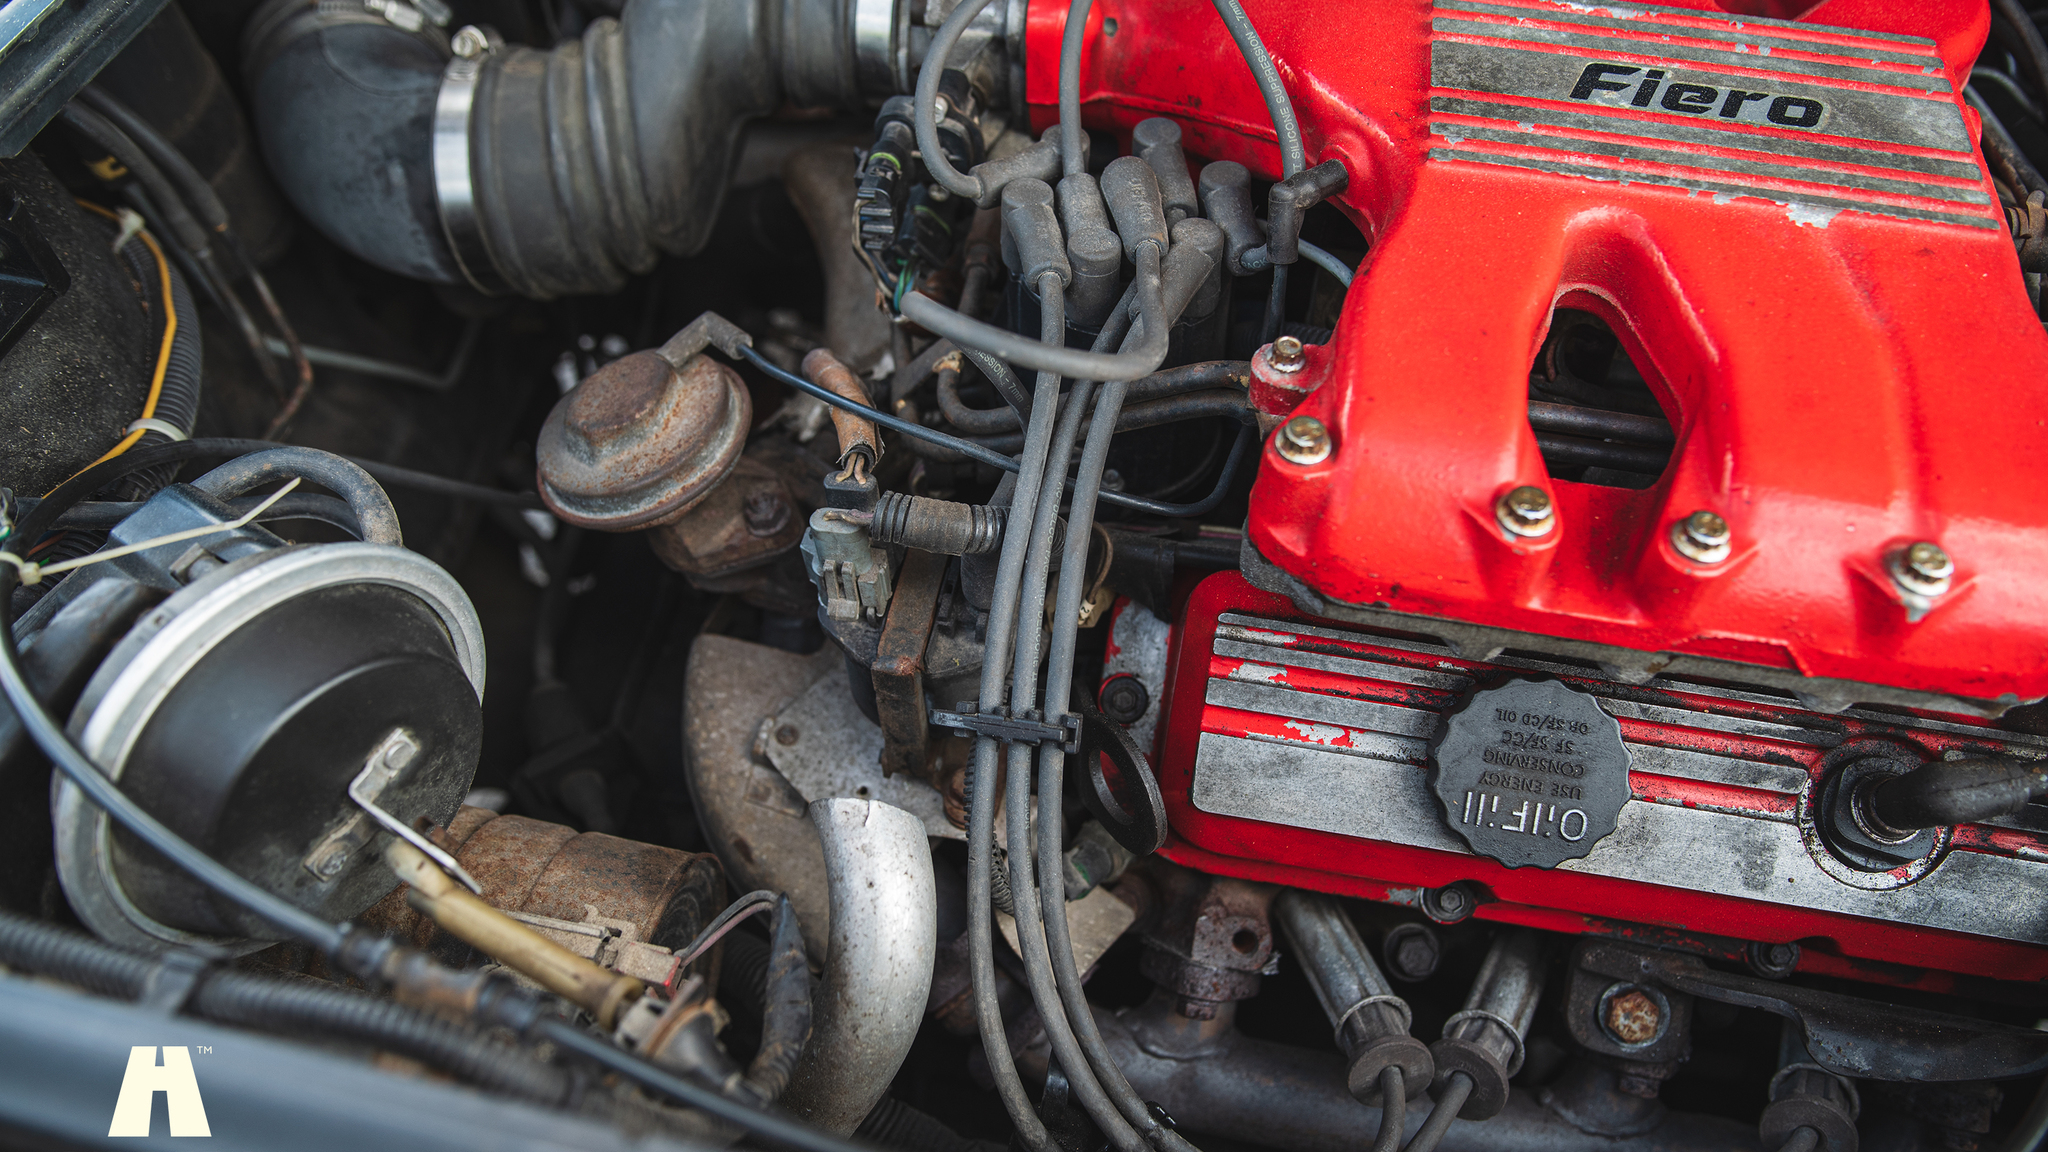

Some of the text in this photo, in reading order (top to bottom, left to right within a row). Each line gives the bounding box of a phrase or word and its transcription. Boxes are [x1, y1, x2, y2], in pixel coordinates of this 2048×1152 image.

[1245, 31, 1285, 104] SUPPRESSION
[1569, 61, 1825, 128] Fiero
[1280, 106, 1301, 159] SILICONE
[975, 350, 1007, 379] ESSION
[1008, 382, 1024, 403] 7mm
[1495, 708, 1588, 735] OR SF/CD OIL
[1502, 730, 1575, 755] SF SF/CC
[1483, 750, 1585, 778] CONSERVING
[1479, 771, 1582, 800] USE ENERGY
